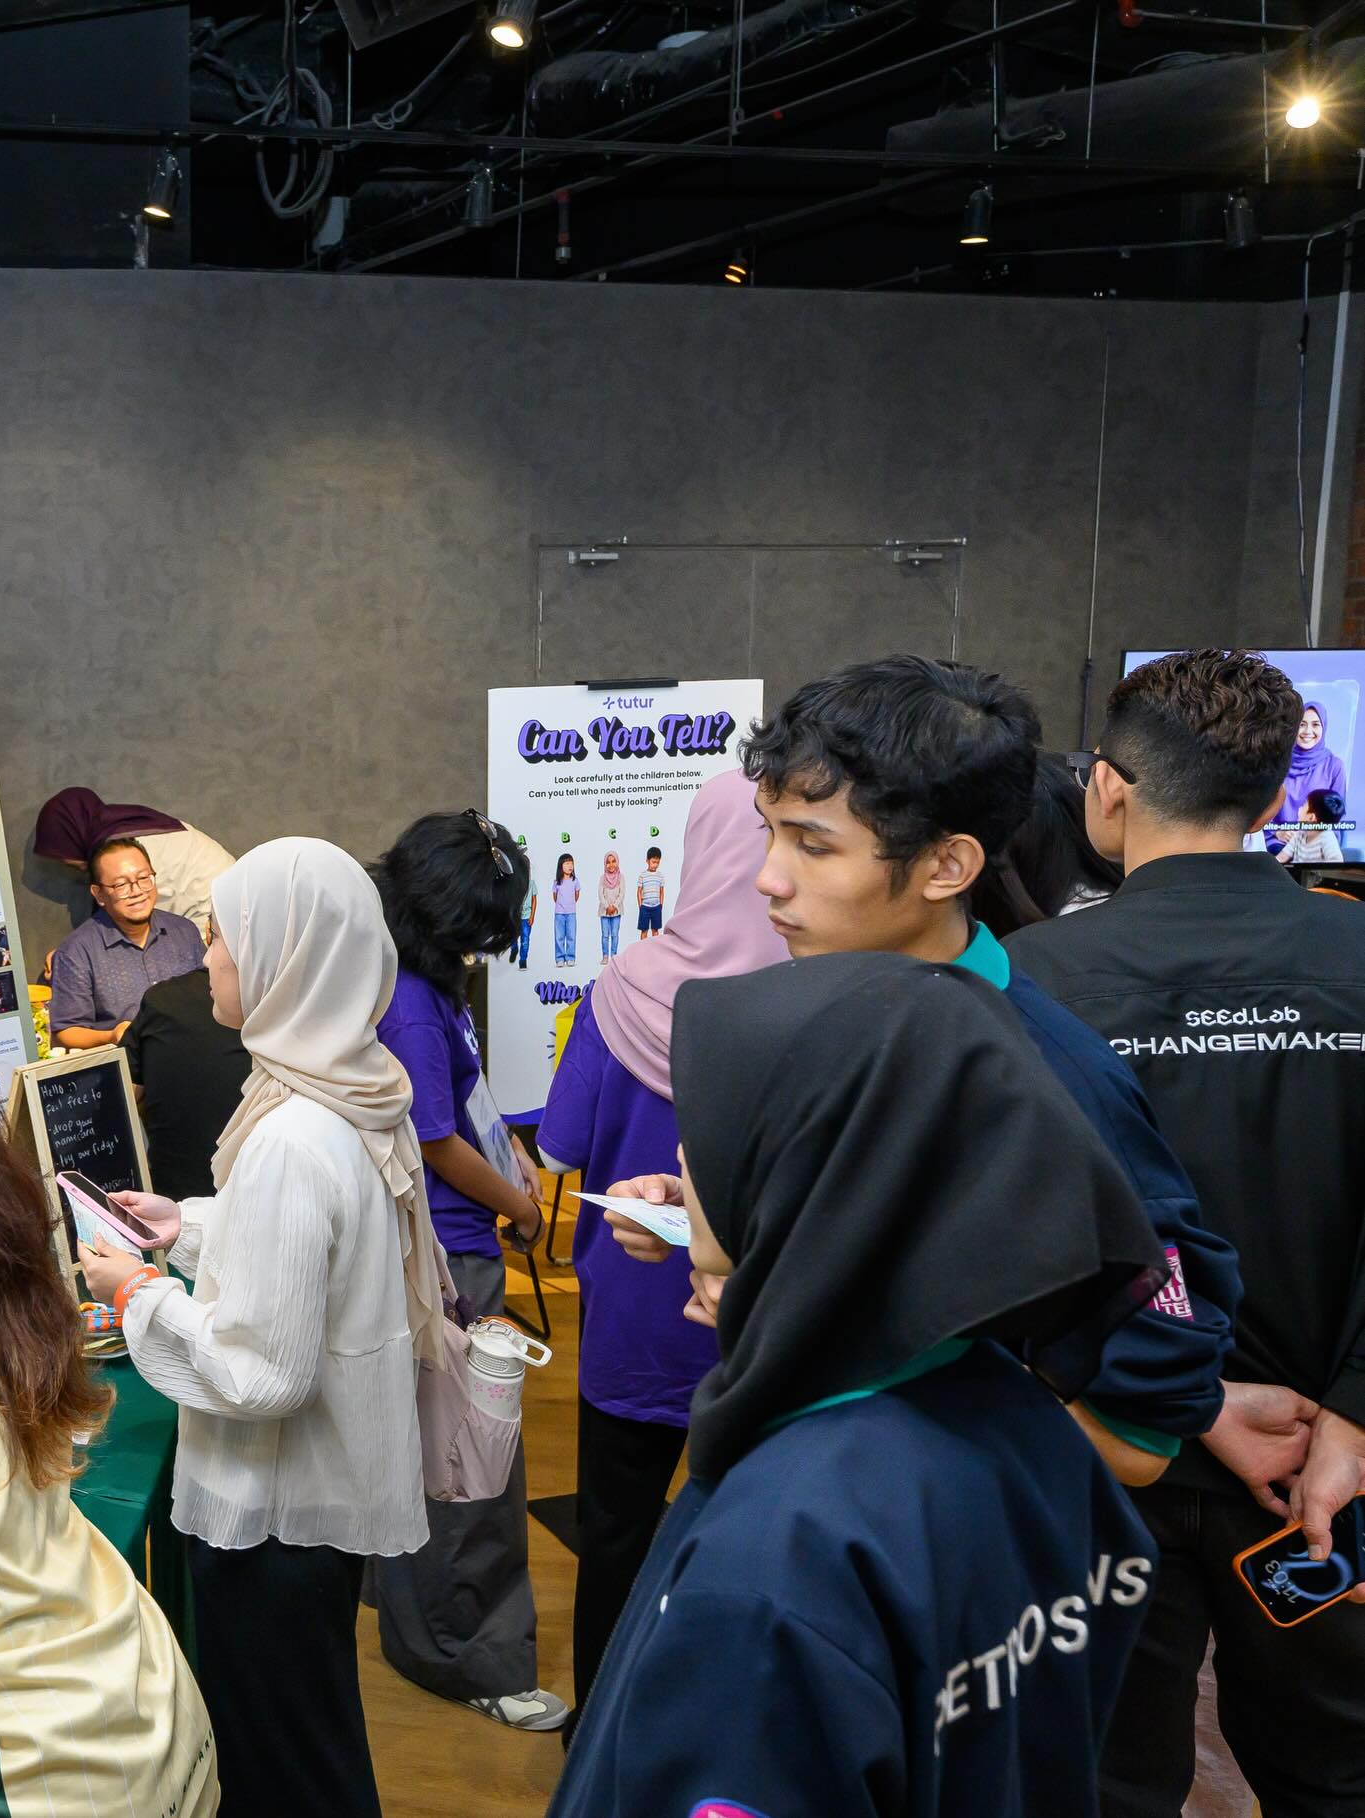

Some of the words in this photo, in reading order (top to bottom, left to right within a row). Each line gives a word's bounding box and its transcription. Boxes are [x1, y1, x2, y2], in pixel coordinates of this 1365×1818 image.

[617, 695, 654, 710] tutur
[518, 718, 587, 763] Can
[588, 714, 659, 760] You
[658, 711, 736, 756] Tell?
[554, 776, 574, 784] Look
[576, 773, 613, 783] carefully
[640, 771, 675, 779] children
[676, 770, 703, 778] below.
[529, 790, 547, 798] Can
[548, 790, 564, 799] you
[565, 788, 579, 796] tell
[581, 787, 598, 795] who
[600, 786, 626, 794] needs
[627, 783, 693, 793] communication
[597, 799, 613, 809] just
[615, 799, 625, 808] by
[627, 797, 663, 807] looking?
[560, 831, 570, 843] B
[608, 828, 617, 839] C
[649, 826, 660, 837] D
[1301, 822, 1332, 831] learning
[1333, 822, 1354, 830] video
[534, 980, 582, 1006] Why
[1109, 1031, 1365, 1056] CHANGEMAKE
[41, 1085, 64, 1097] Hello
[67, 1094, 88, 1109] free
[92, 1088, 101, 1101] to
[55, 1127, 95, 1148] namecard
